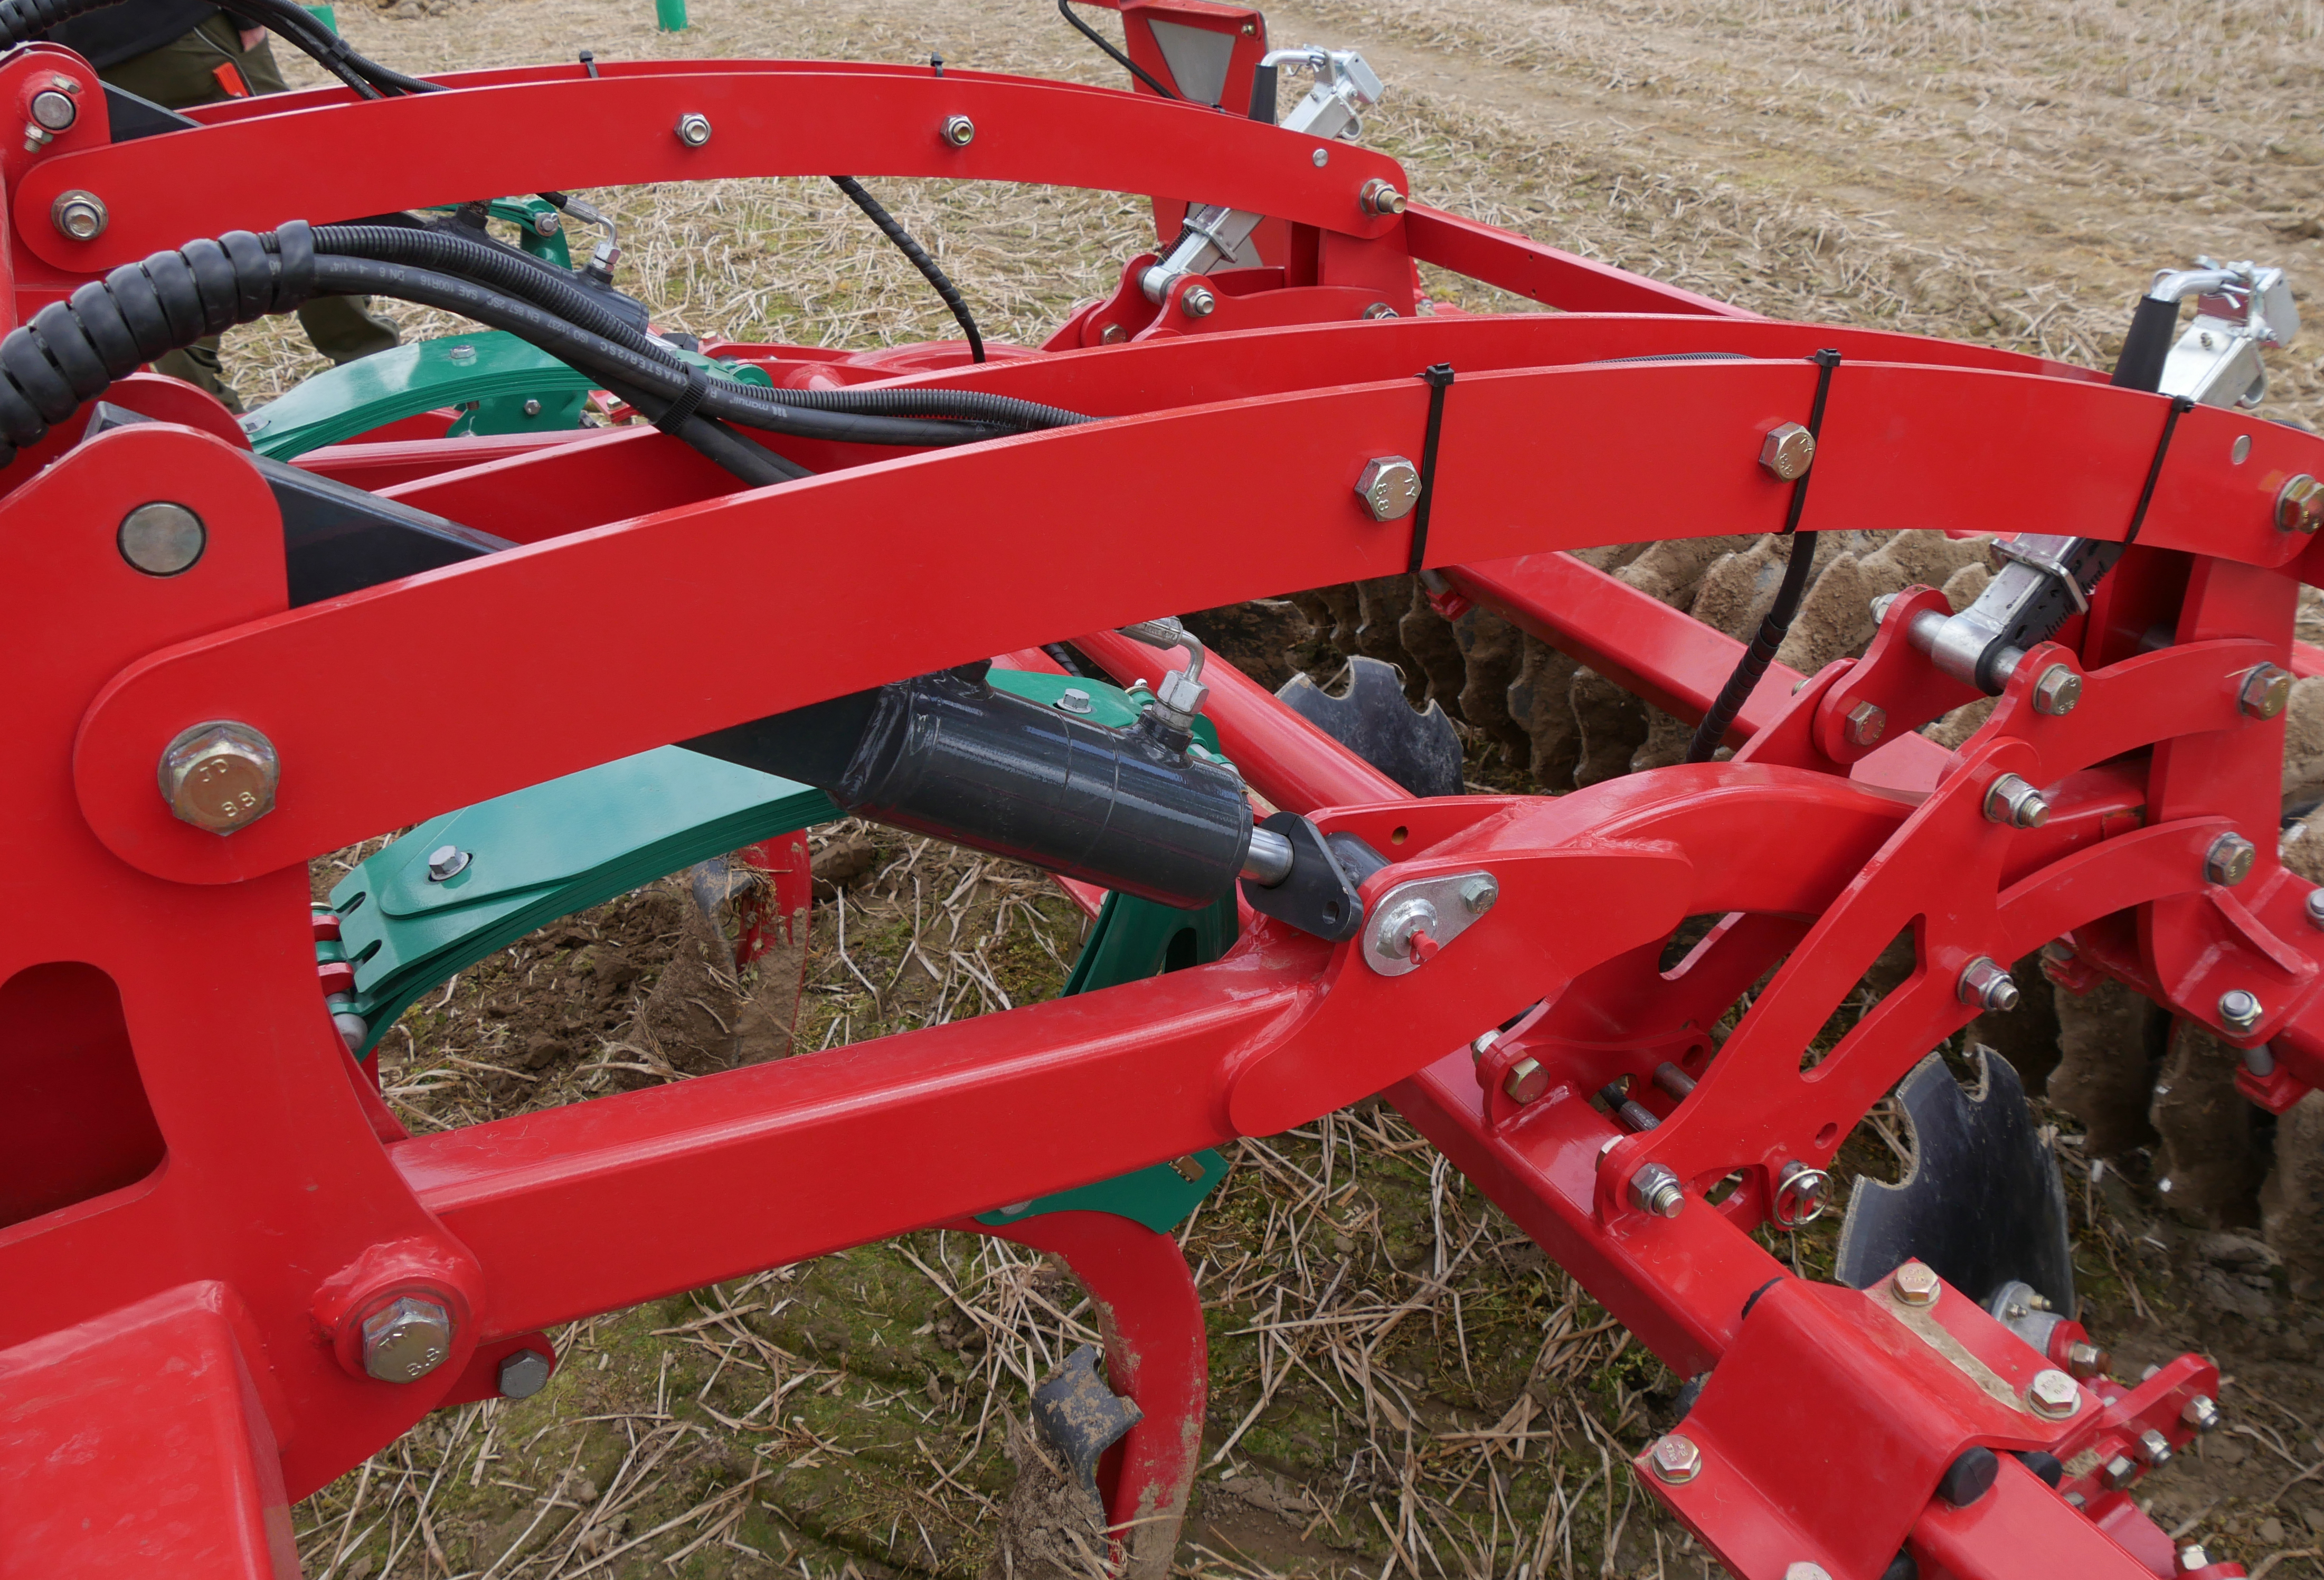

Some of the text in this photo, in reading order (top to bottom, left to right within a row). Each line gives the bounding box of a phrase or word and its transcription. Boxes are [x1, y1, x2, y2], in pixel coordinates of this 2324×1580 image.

[379, 267, 385, 277] 6
[390, 268, 404, 281] DN
[421, 275, 454, 292] 100R16
[458, 286, 478, 300] SAE
[486, 295, 505, 309] 2SC
[508, 304, 524, 316] 857
[527, 310, 540, 323] EN
[547, 319, 569, 334] 11237
[573, 330, 589, 344] ISO
[1404, 474, 1416, 497] TY
[1376, 482, 1390, 511] 8.8
[221, 791, 256, 817] 8.8
[407, 1348, 440, 1376] 8.8
